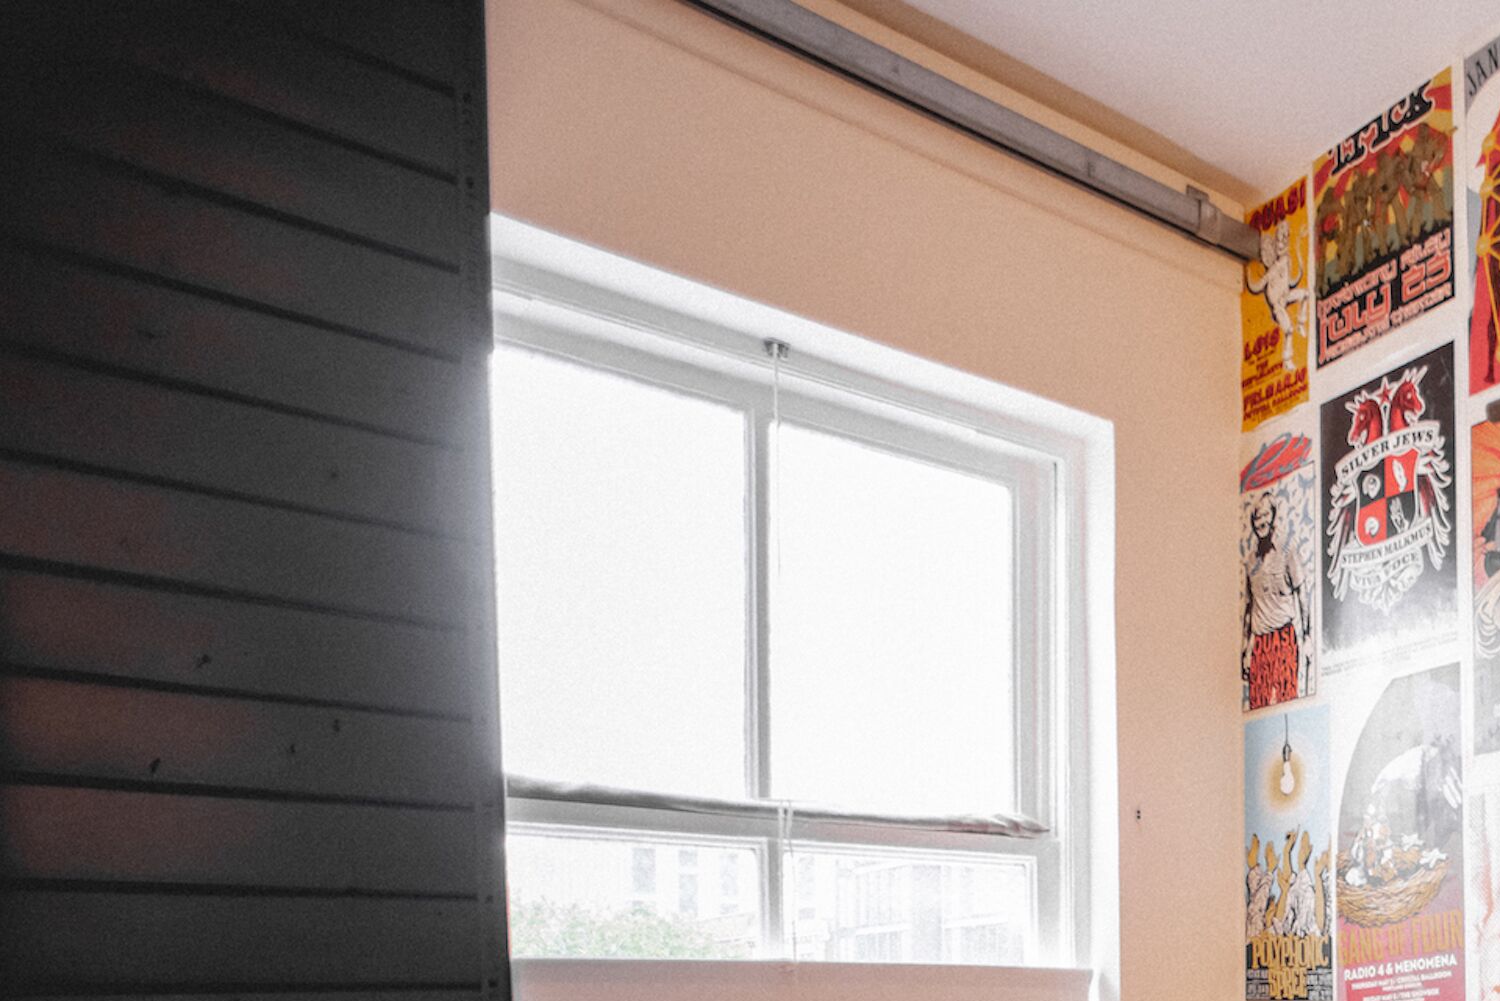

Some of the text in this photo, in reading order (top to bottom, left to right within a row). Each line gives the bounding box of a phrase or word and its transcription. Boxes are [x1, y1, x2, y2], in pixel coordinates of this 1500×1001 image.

[1341, 441, 1391, 475] SILVER
[1393, 429, 1435, 449] JEWS
[1342, 524, 1432, 565] STEPHEN MALKMUS
[1252, 935, 1328, 970] POLYPHONIC
[1411, 910, 1463, 955] FOUR
[1344, 965, 1376, 981] RADIO
[1377, 963, 1385, 976] 4
[1395, 953, 1457, 973] MENOMENA
